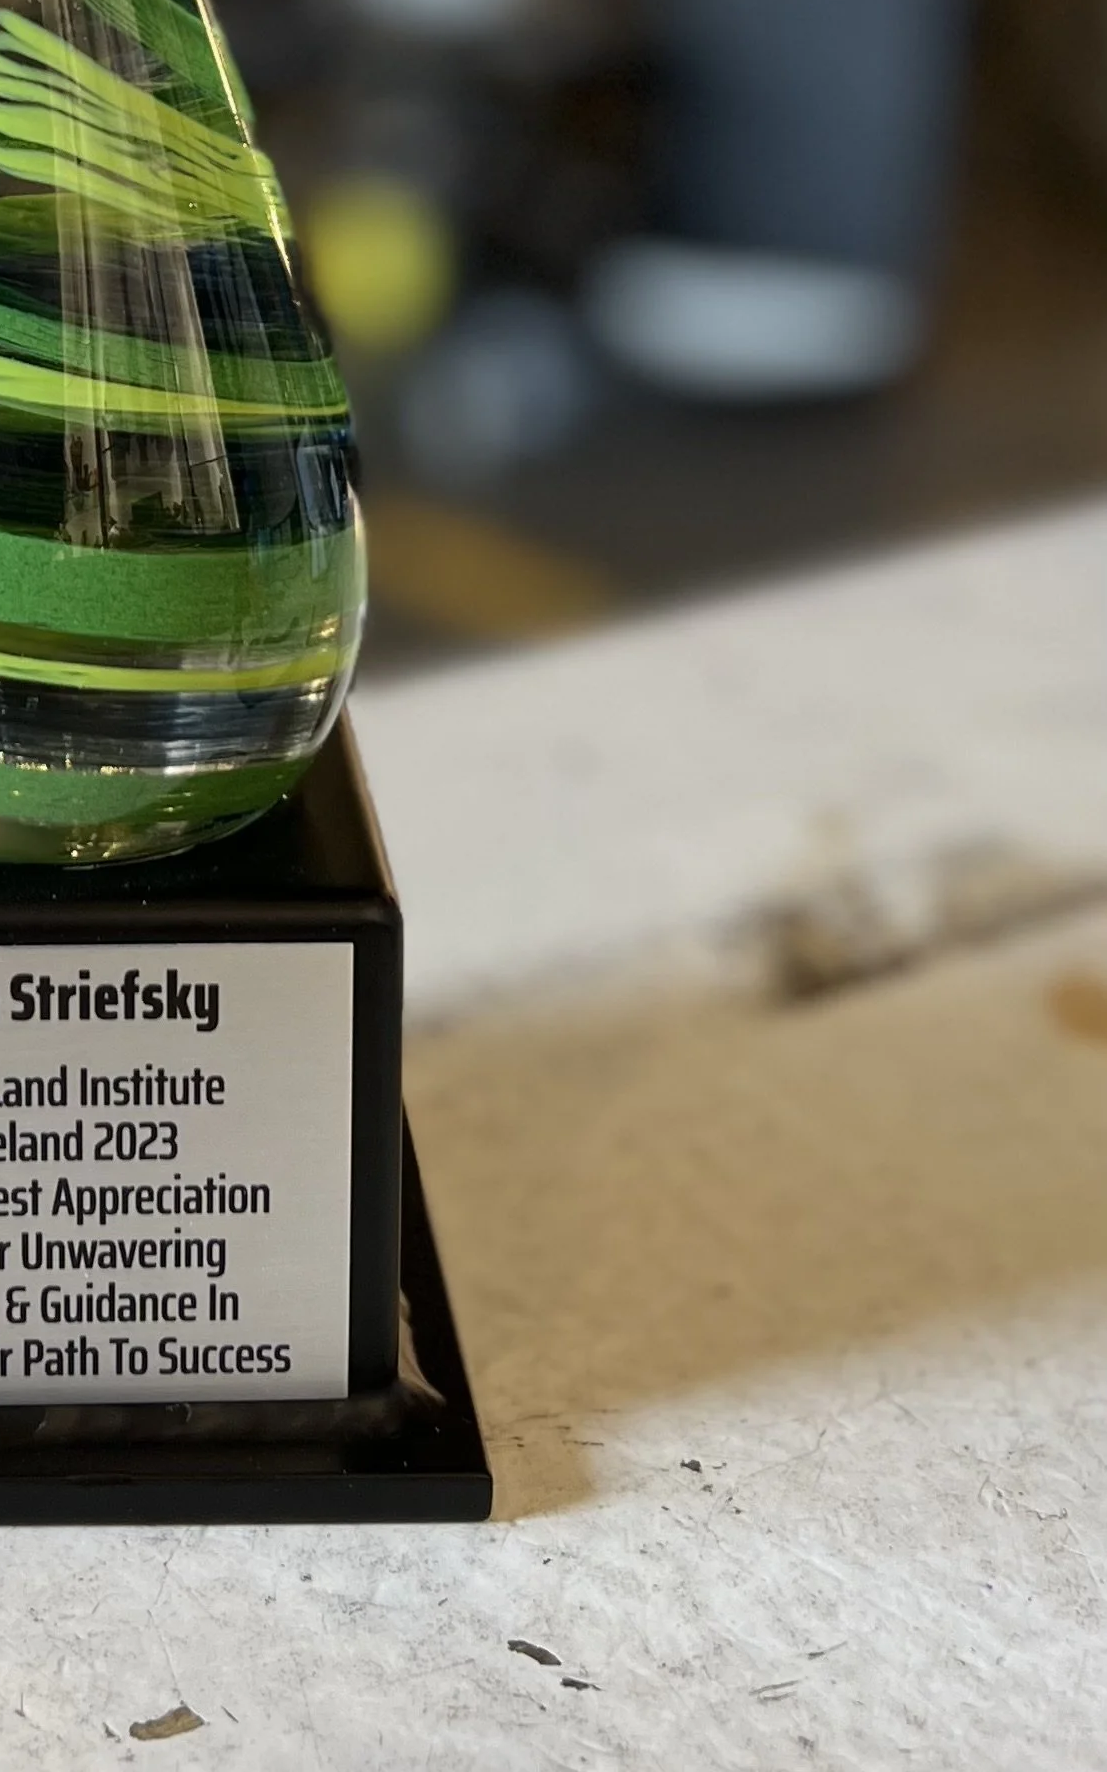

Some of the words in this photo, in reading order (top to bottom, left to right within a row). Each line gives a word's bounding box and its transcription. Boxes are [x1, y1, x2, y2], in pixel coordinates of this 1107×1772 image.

[9, 968, 220, 1033] Striefsky
[79, 1063, 226, 1107] Institute
[93, 1121, 179, 1162] 2023
[51, 1172, 271, 1227] Appreciation
[21, 1226, 227, 1279] Unwavering
[5, 1285, 31, 1325] &
[40, 1281, 198, 1324] Guidance
[208, 1283, 239, 1322] In
[23, 1336, 100, 1378] Path
[108, 1337, 149, 1377] To
[158, 1336, 292, 1376] Success
